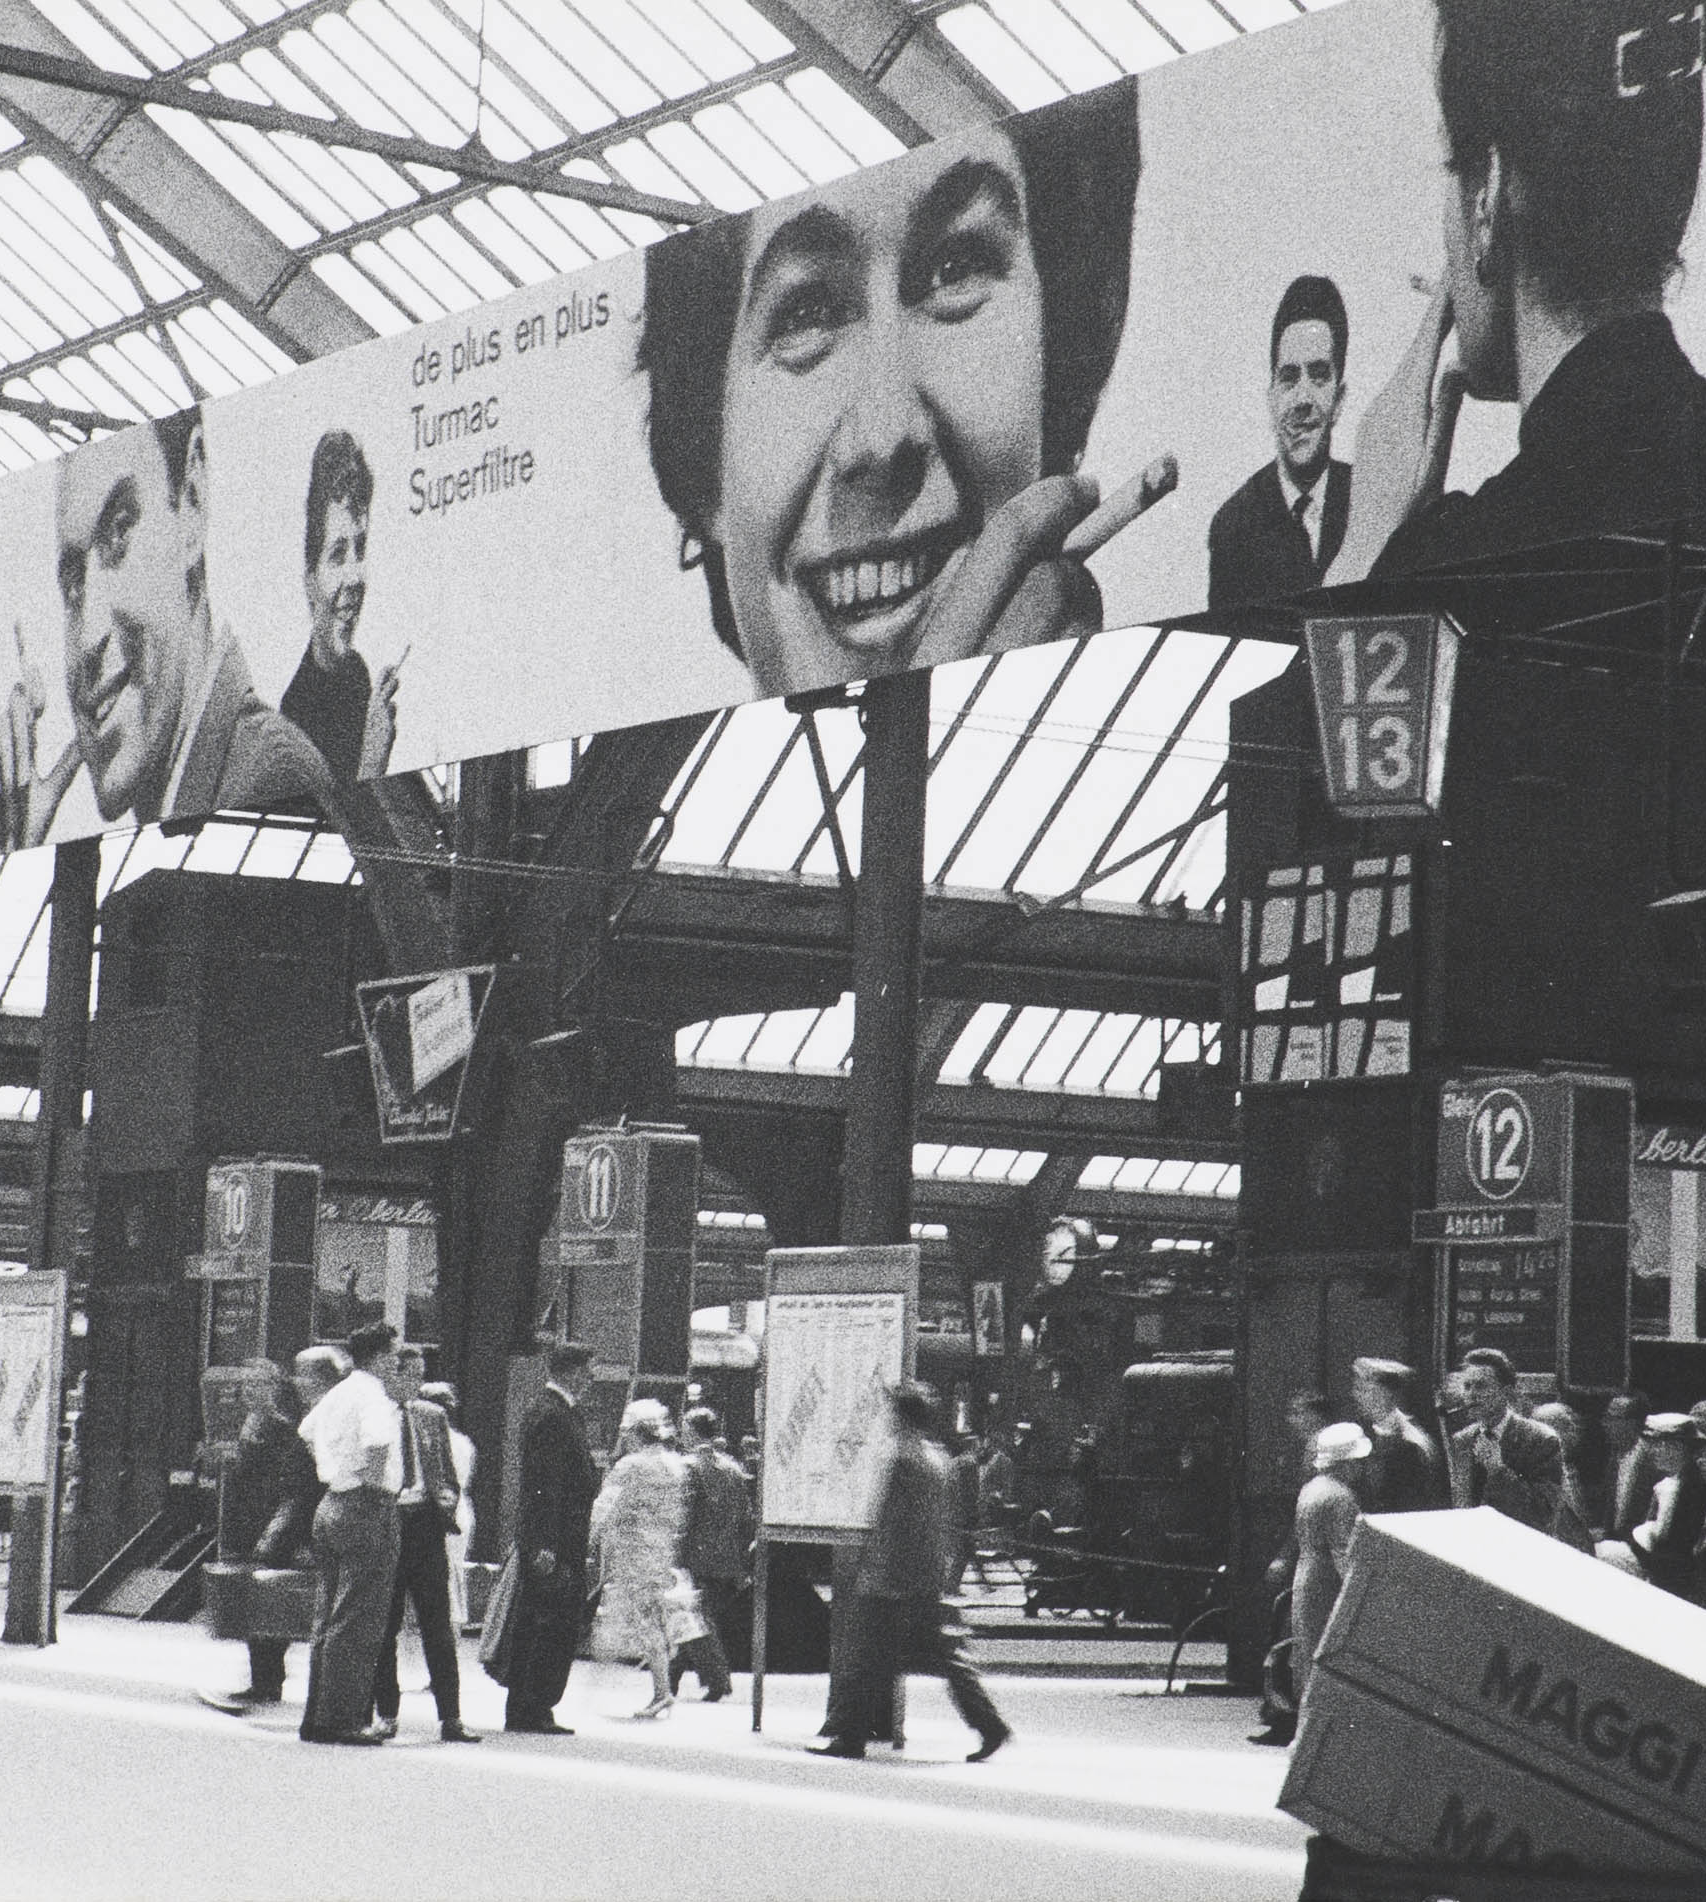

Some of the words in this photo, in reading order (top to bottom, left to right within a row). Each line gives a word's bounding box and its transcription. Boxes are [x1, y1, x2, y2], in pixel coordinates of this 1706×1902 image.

[411, 342, 444, 387] de
[450, 326, 501, 383] plus
[515, 311, 545, 354] en
[555, 291, 610, 346] plus
[410, 394, 499, 453] Turmac
[409, 446, 536, 516] Superfiltre
[1336, 629, 1410, 705] 12
[1339, 715, 1413, 791] 13
[1475, 1107, 1524, 1181] 12
[224, 1184, 247, 1236] 10
[587, 1155, 612, 1219] 11
[1445, 1213, 1506, 1236] Abfahrt
[1479, 1643, 1705, 1794] MAGGI
